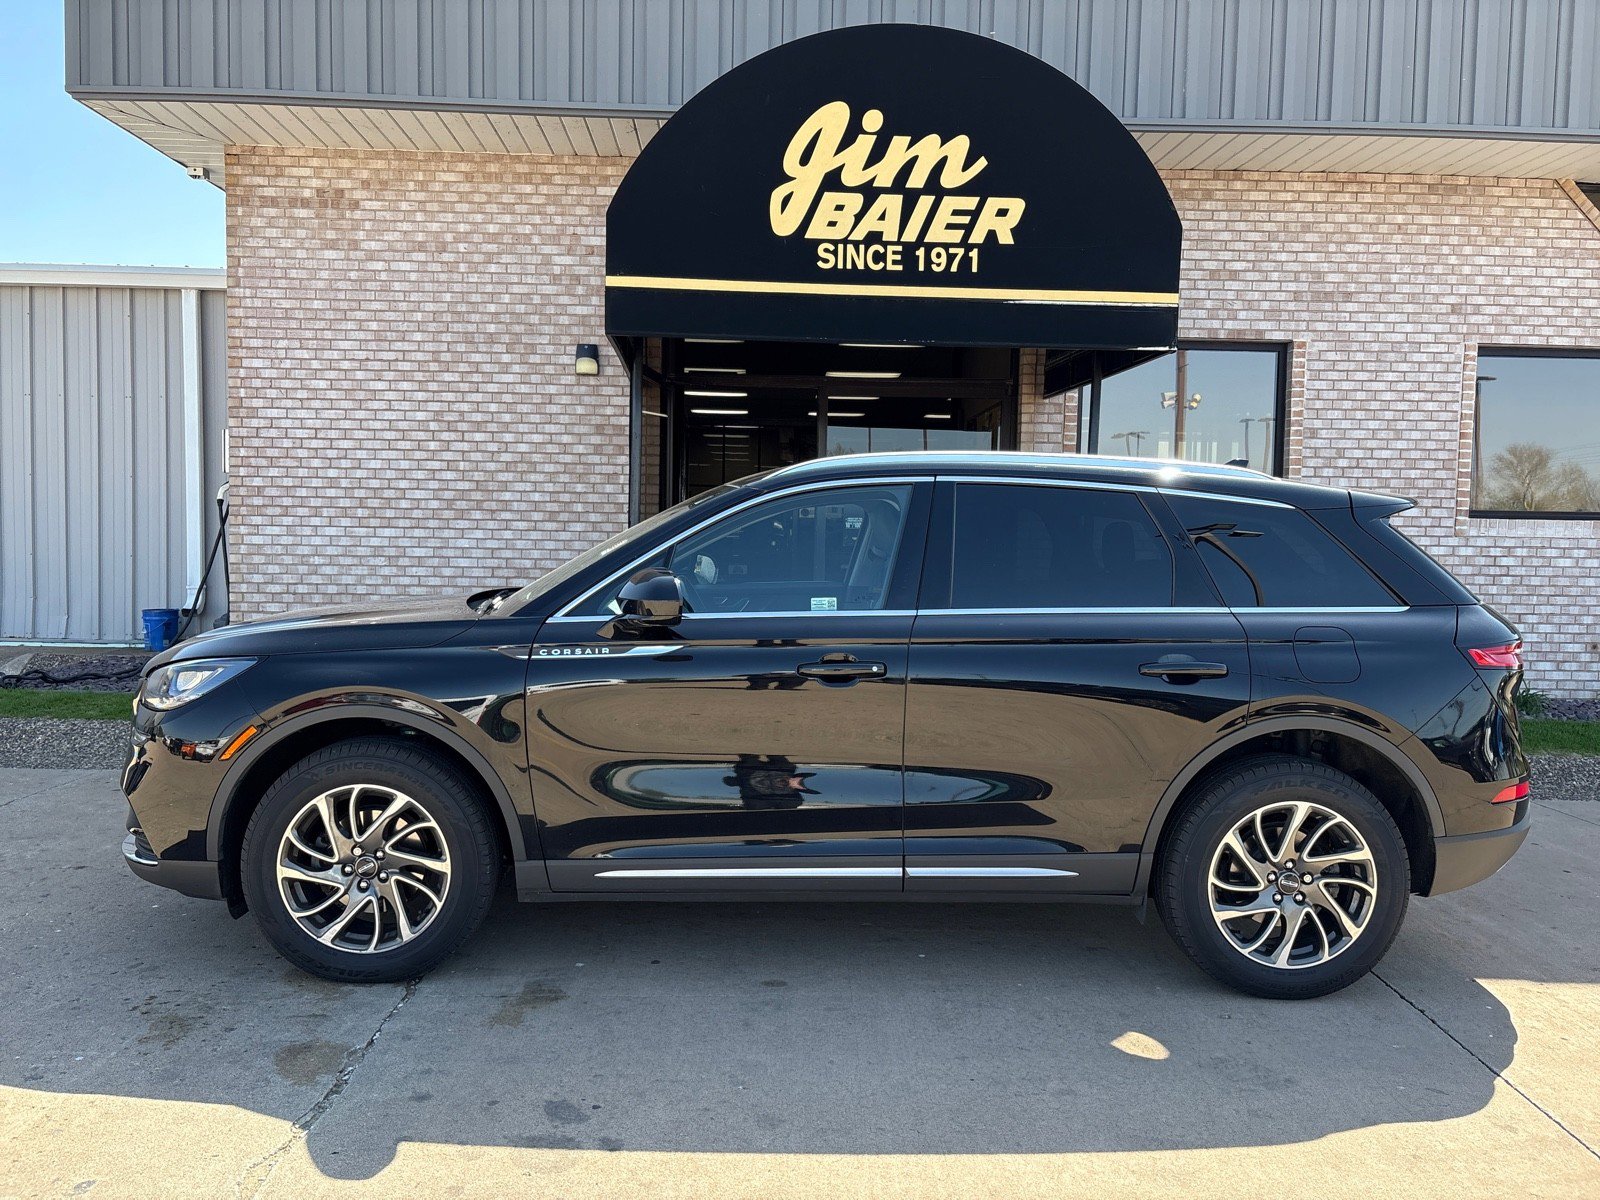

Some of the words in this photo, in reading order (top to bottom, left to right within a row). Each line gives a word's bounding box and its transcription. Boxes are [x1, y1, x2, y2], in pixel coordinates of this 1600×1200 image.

[770, 101, 988, 236] Jim
[805, 192, 1026, 244] BAIER
[816, 242, 903, 271] SINCE
[914, 246, 980, 273] 1971
[539, 646, 611, 656] CORSAIR
